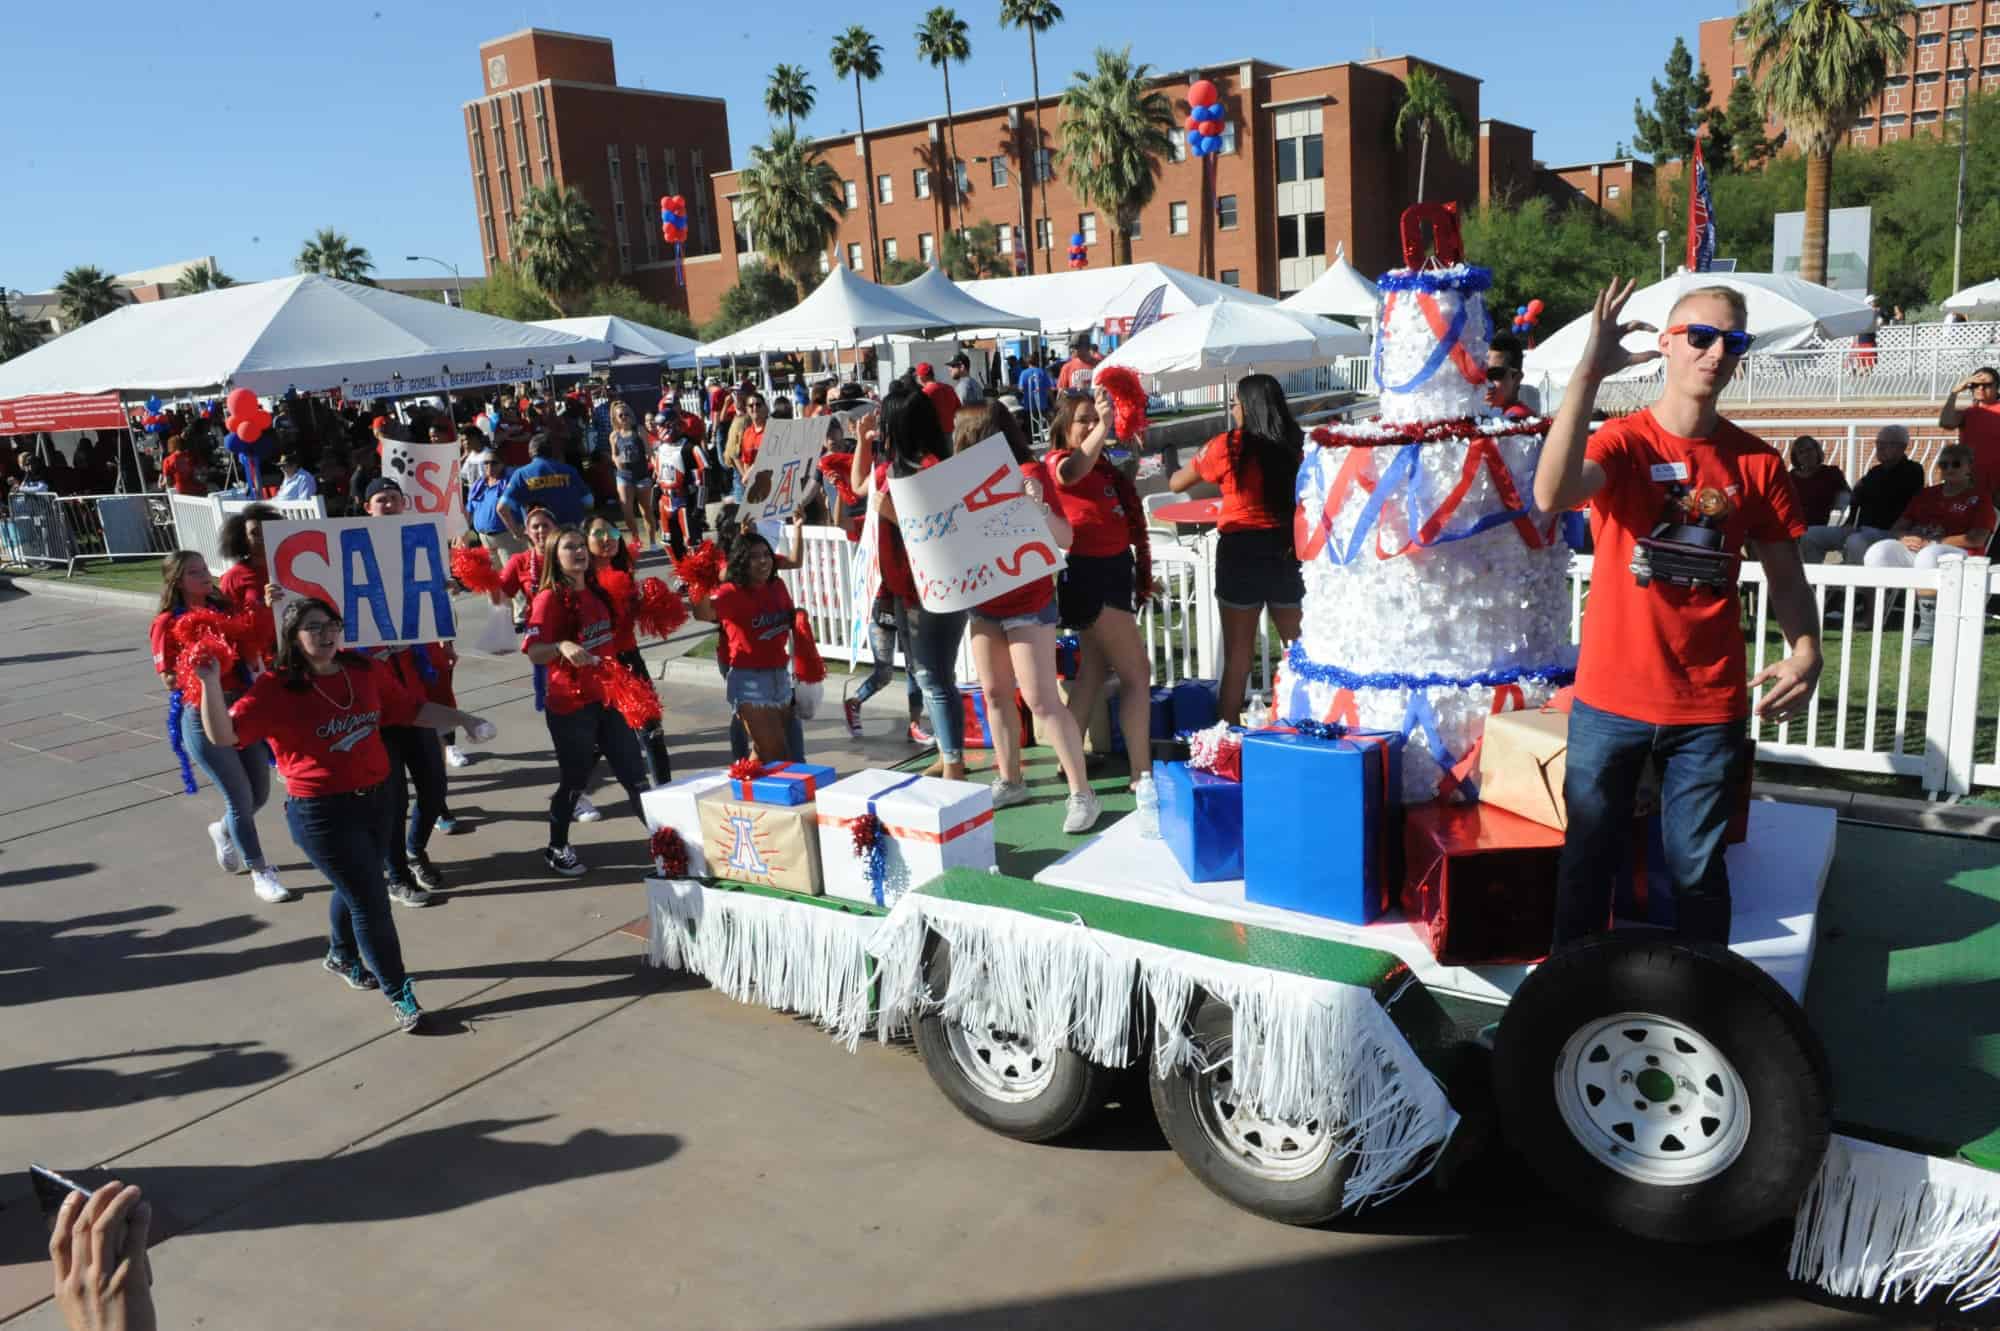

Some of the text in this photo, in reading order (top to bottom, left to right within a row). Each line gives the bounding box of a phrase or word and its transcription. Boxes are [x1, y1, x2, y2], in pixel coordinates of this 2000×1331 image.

[352, 381, 391, 398] COLLEGE
[393, 380, 404, 393] OF
[408, 375, 440, 392] SOCIAL
[450, 366, 497, 386] BEHAVIORAL
[499, 365, 534, 380] SCIENCES
[527, 473, 571, 490] SECURITY
[273, 522, 457, 642] SAA
[315, 711, 381, 738] Arizon
